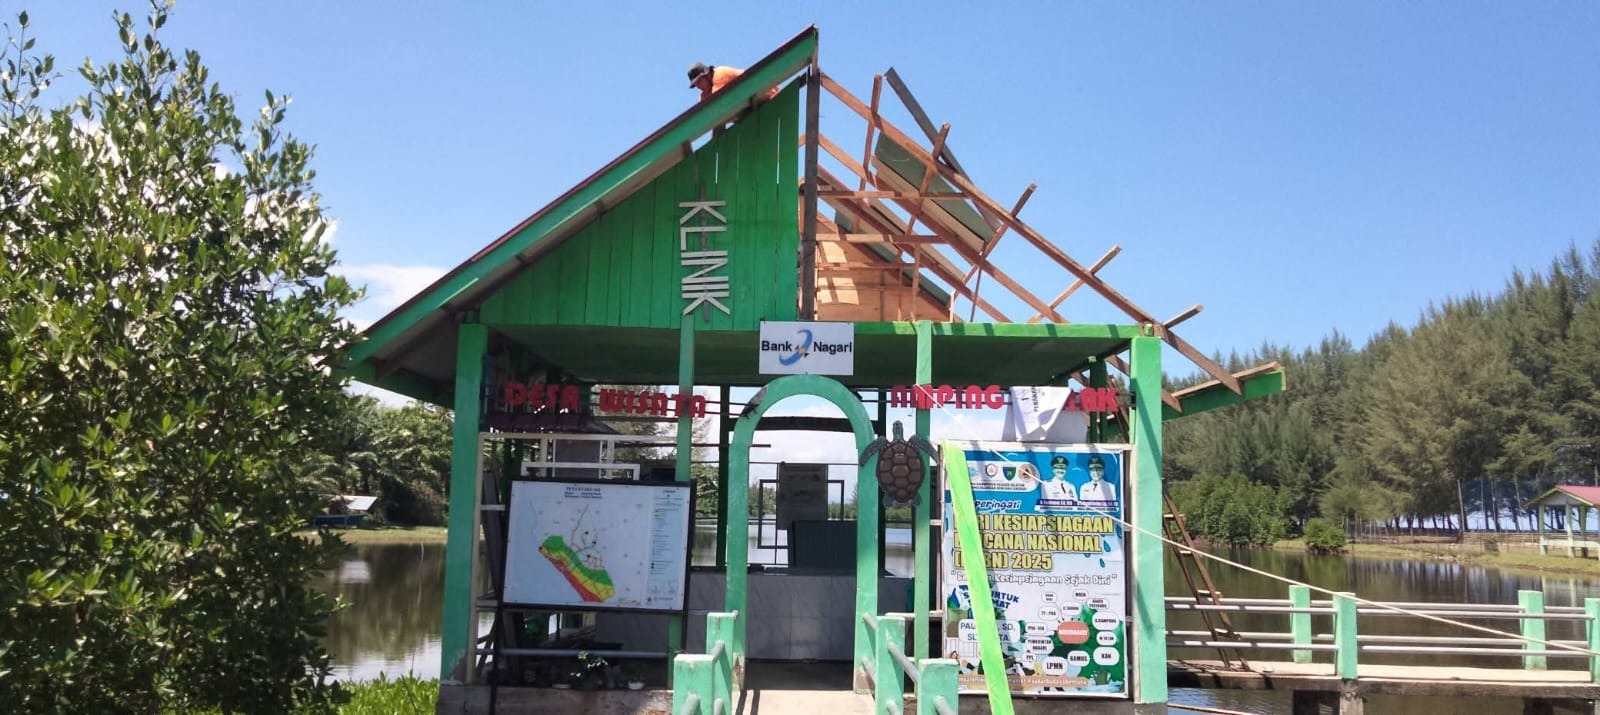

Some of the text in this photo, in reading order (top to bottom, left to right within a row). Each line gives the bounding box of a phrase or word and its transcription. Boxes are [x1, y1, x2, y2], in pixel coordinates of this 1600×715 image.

[679, 201, 731, 316] KLINIK
[761, 340, 852, 354] Bank Nagari
[505, 383, 706, 418] DESA WISATA
[891, 385, 1004, 409] AMPING
[993, 515, 1114, 532] KESIAPSIAGAAN
[1027, 535, 1102, 552] NASIONAL
[1012, 554, 1053, 570] 2025
[1046, 662, 1064, 670] LPMN
